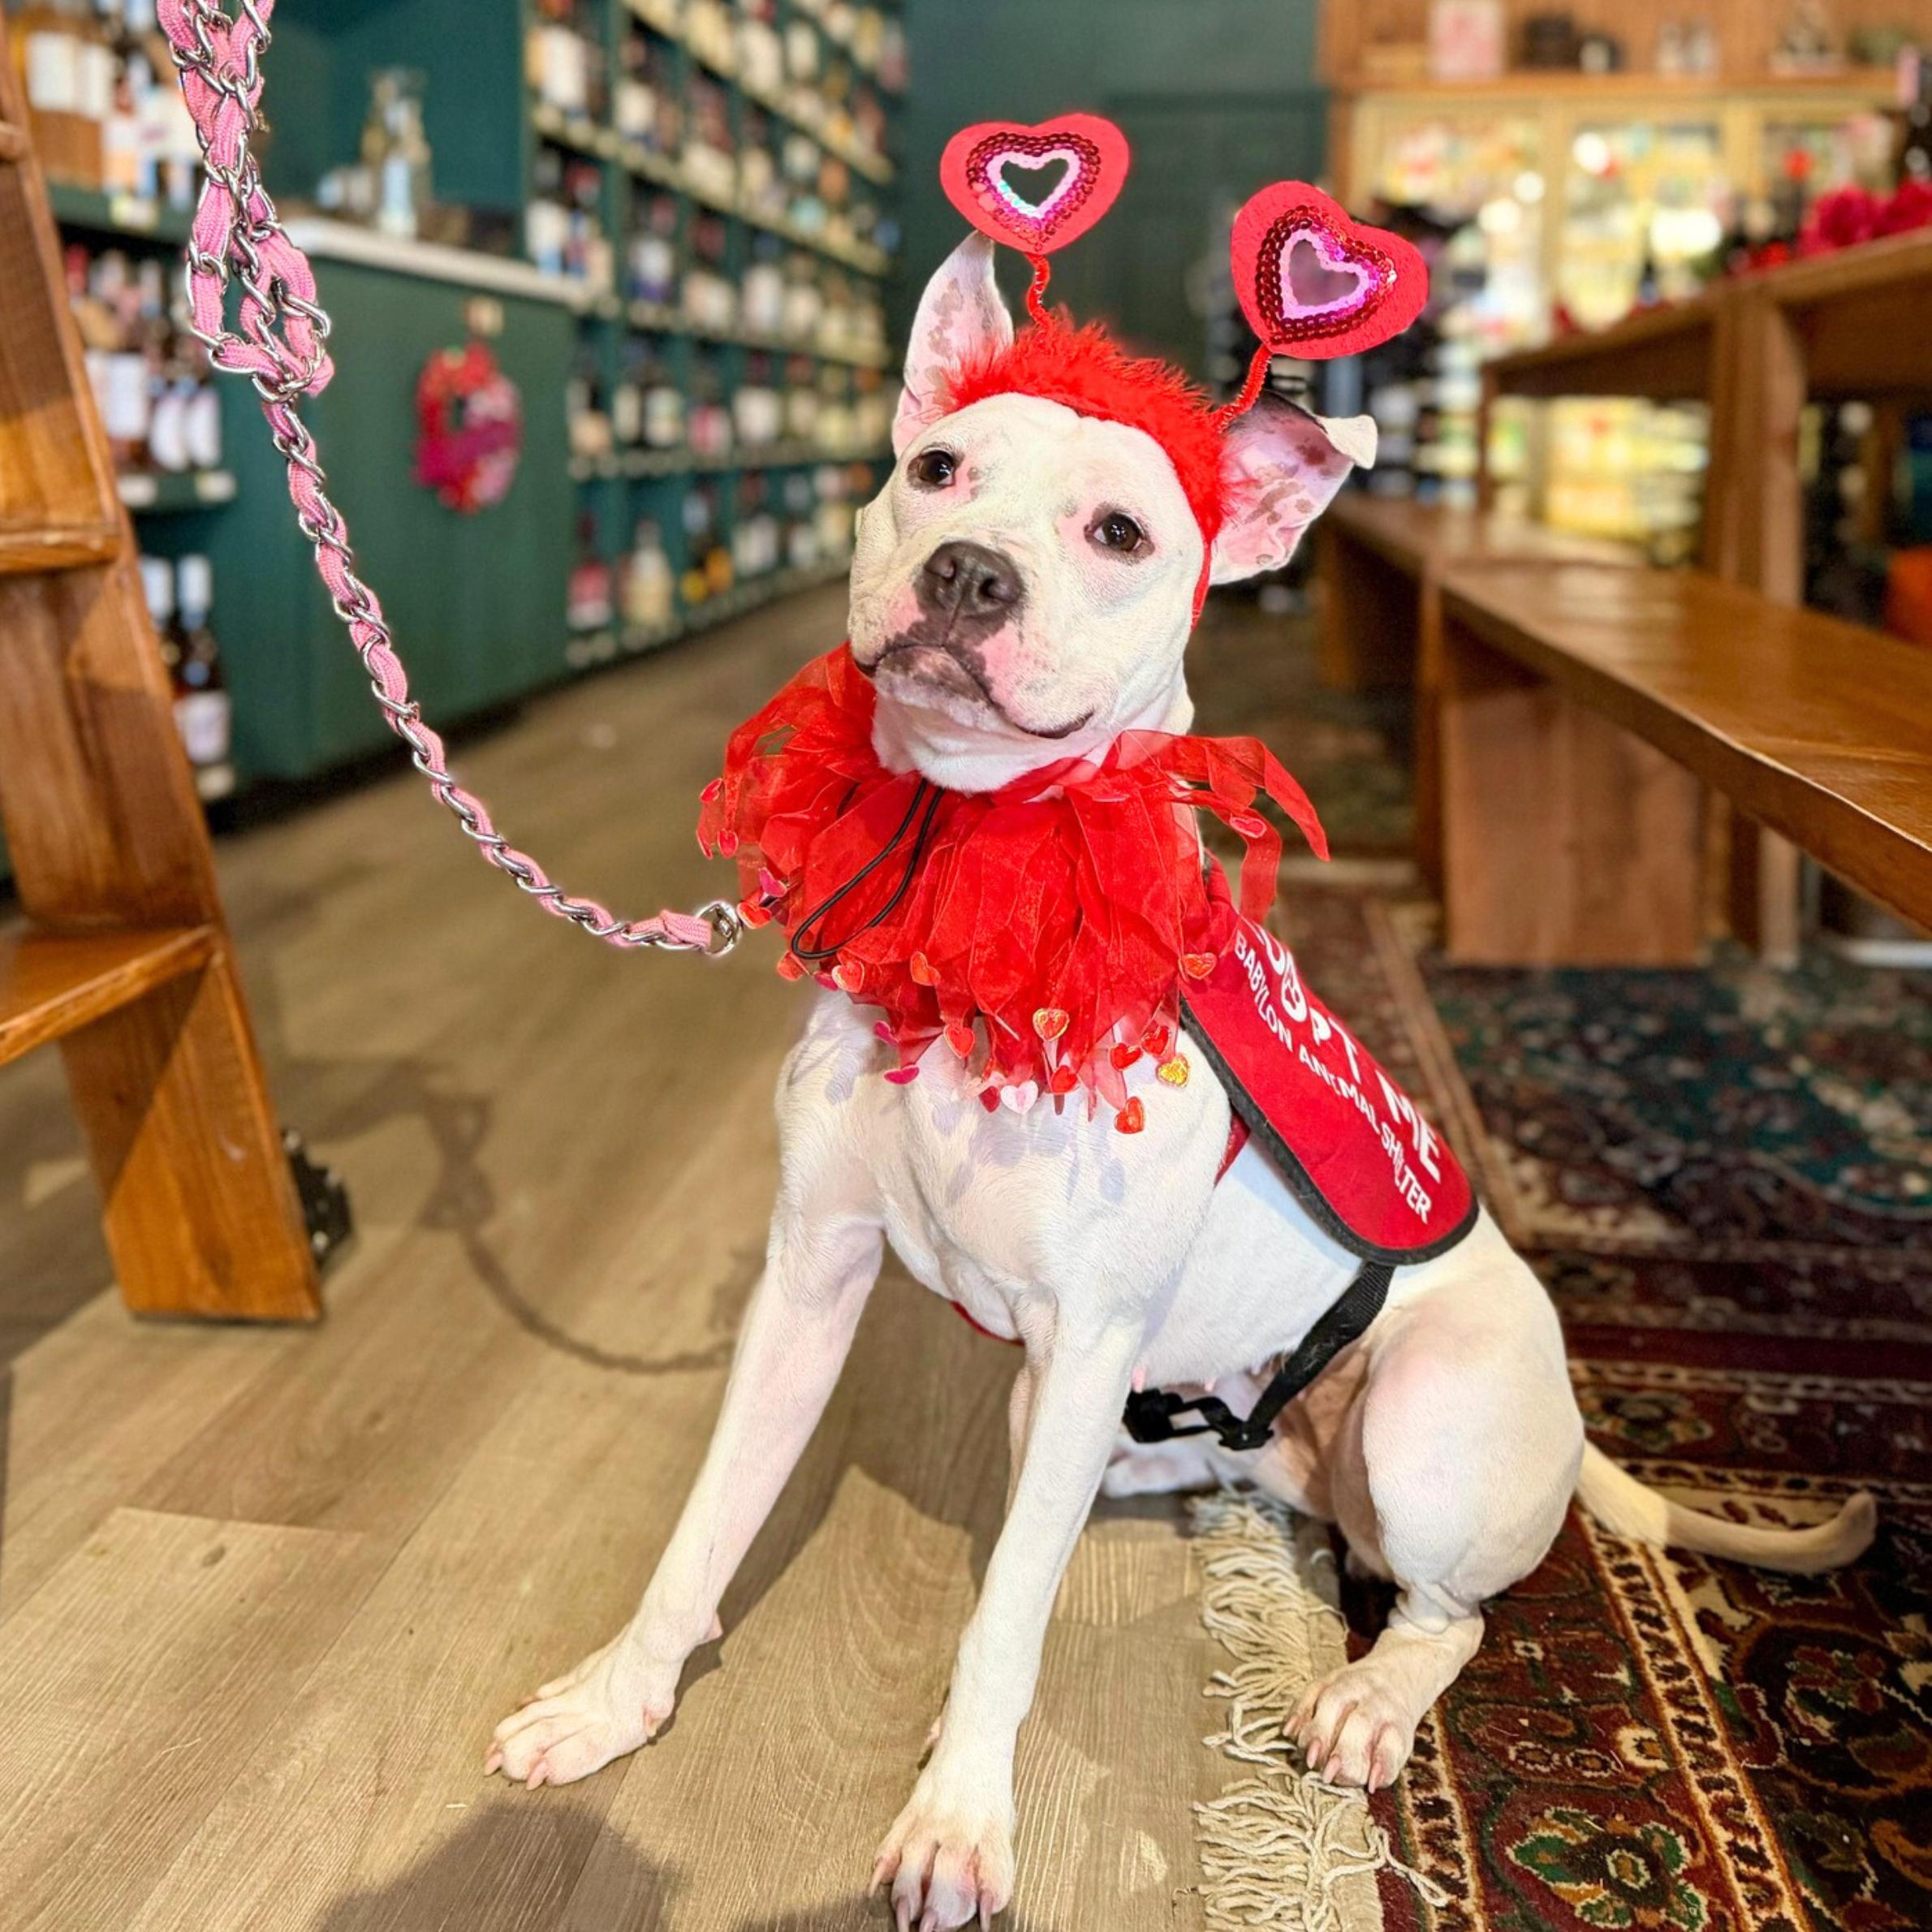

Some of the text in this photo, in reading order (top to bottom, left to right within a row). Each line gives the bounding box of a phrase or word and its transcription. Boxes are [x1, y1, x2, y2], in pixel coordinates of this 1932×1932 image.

[1235, 929, 1432, 1224] BABYLON ANIMAL SHELTER
[1375, 1069, 1441, 1184] ME
